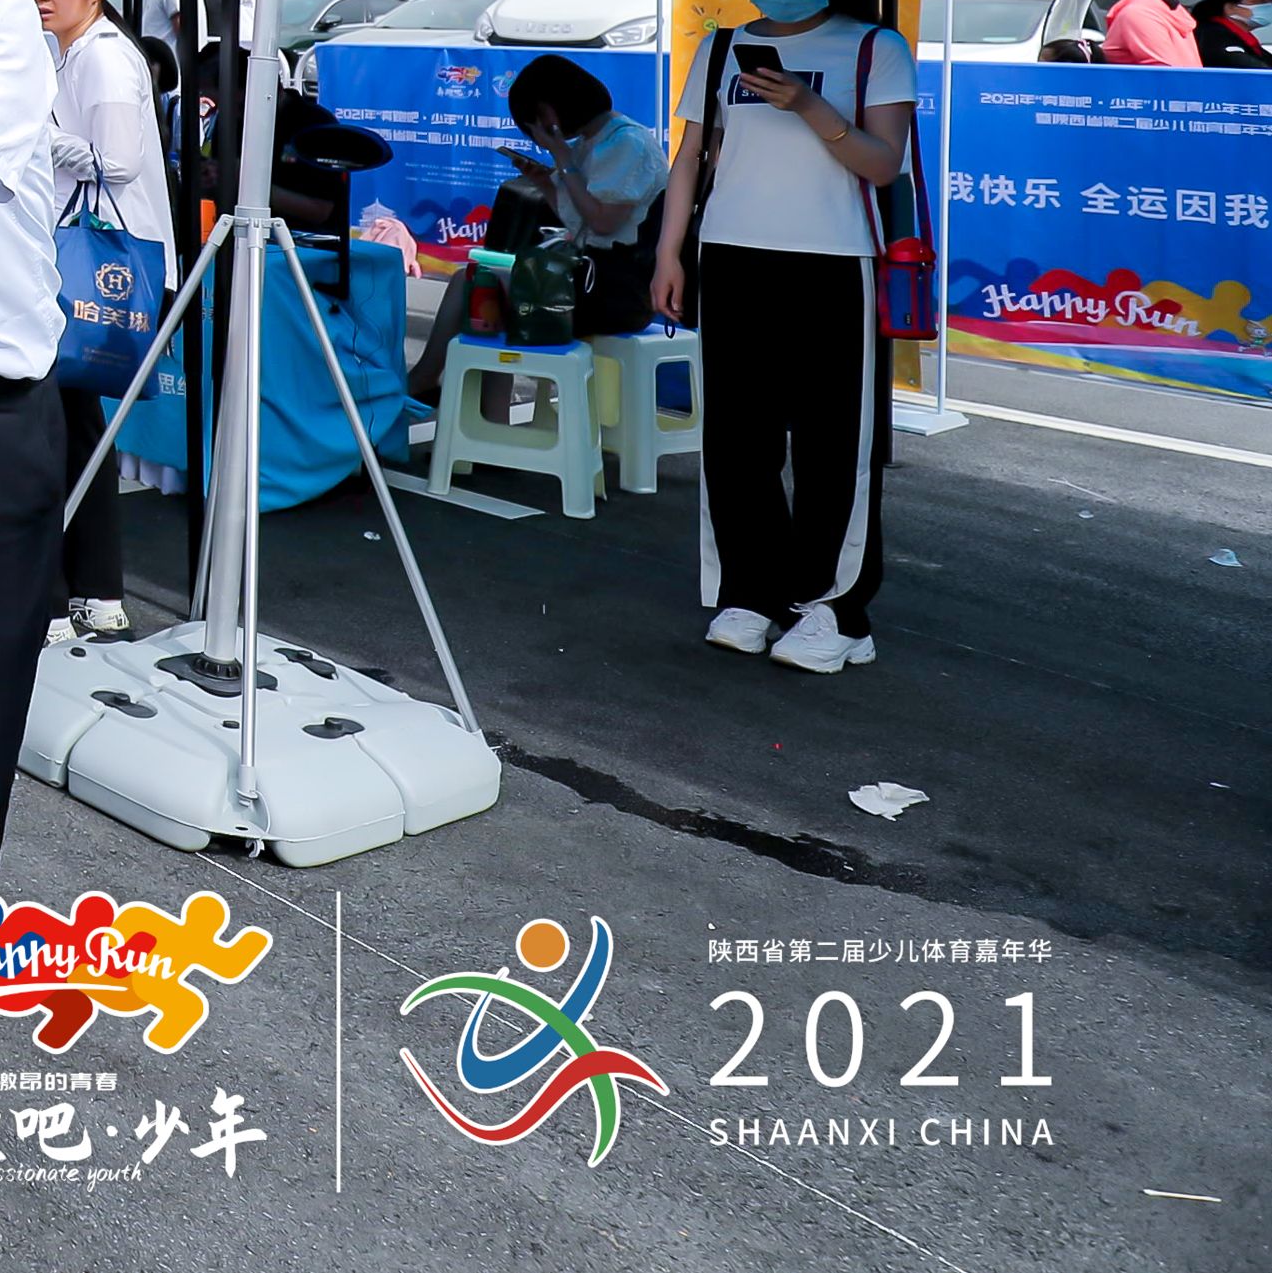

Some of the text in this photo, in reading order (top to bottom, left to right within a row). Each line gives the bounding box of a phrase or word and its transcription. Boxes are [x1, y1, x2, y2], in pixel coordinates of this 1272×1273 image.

[1079, 181, 1270, 229] 全运因我
[72, 299, 151, 333] 哈芙琳
[981, 283, 1202, 338] Happy Run
